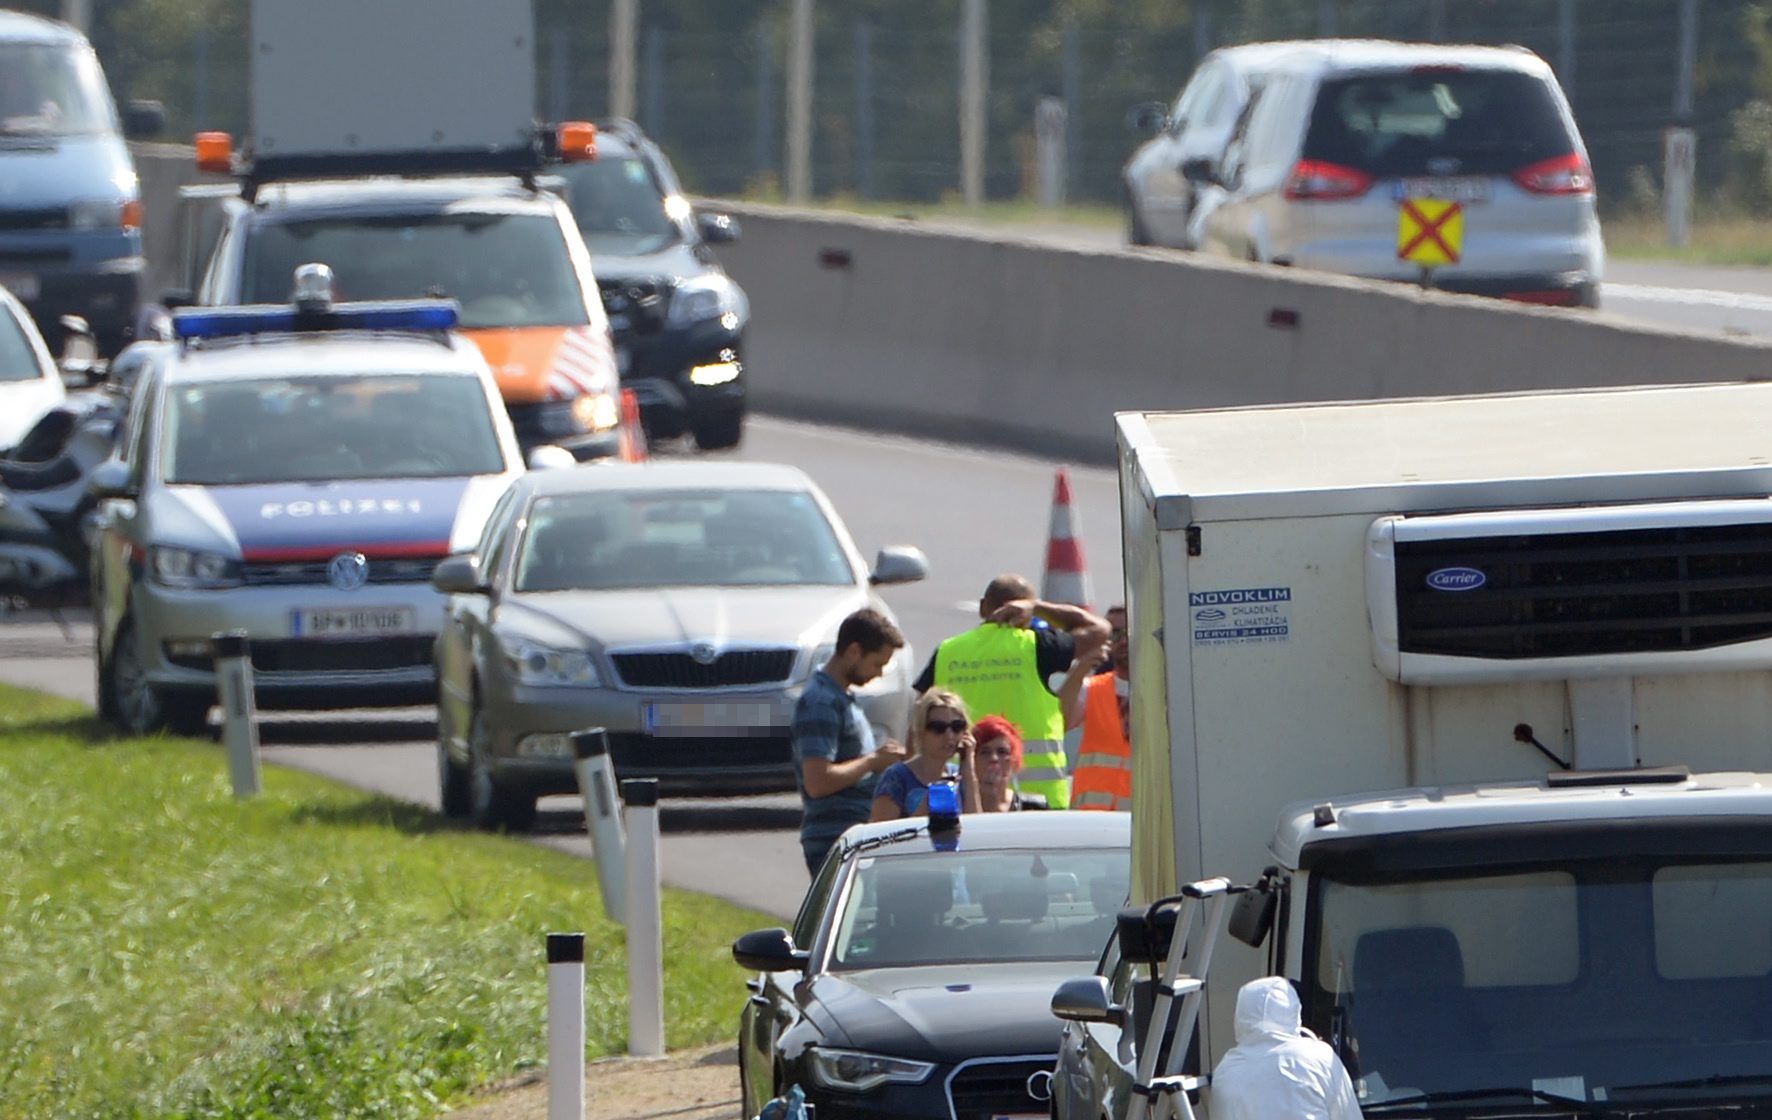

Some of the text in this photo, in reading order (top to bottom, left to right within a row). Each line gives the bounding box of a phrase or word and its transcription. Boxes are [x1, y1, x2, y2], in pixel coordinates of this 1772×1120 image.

[260, 499, 421, 519] POLIZEI
[1434, 572, 1477, 584] Carrier
[1191, 589, 1288, 604] NOVOKLIM
[1196, 630, 1238, 638] SERVIS
[1261, 627, 1287, 635] HOD
